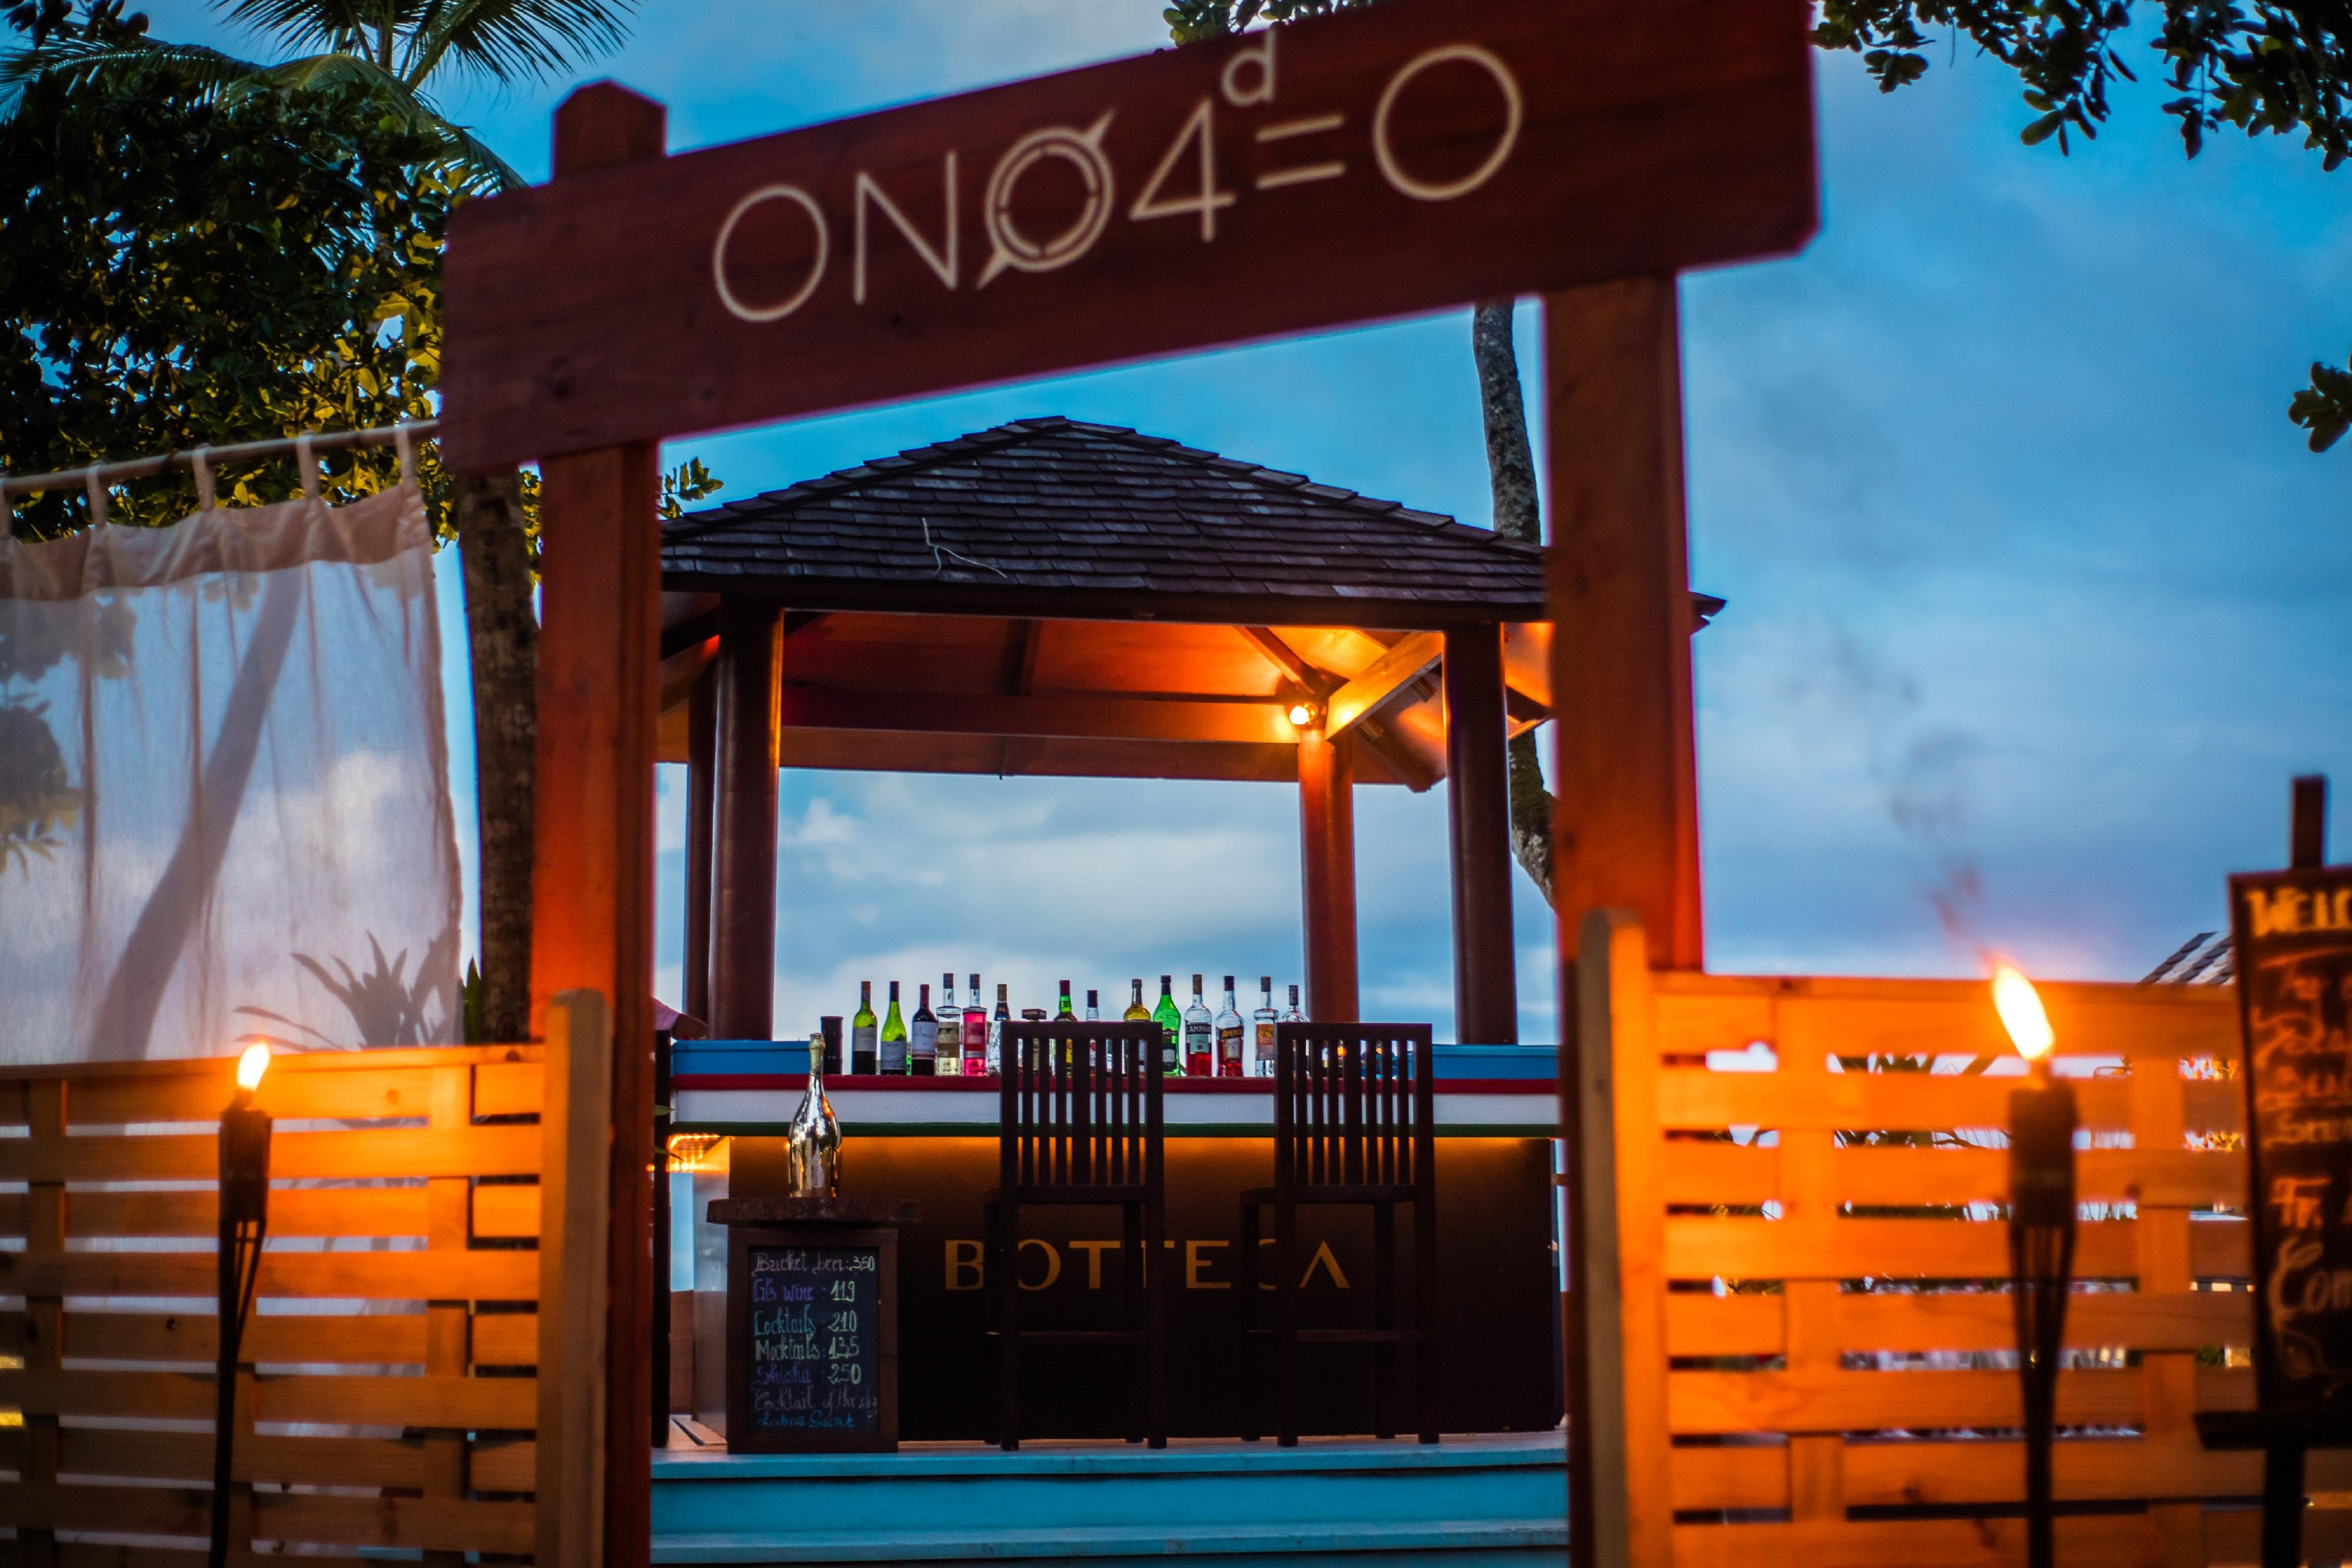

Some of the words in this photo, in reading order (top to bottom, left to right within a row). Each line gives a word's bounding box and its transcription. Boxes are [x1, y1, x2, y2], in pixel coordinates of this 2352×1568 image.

[849, 1255, 875, 1271] 350
[944, 1238, 1351, 1291] BOTEA
[831, 1279, 856, 1302] 119
[753, 1304, 816, 1336] Cocktails
[828, 1309, 857, 1332] 210
[828, 1363, 862, 1386] 250
